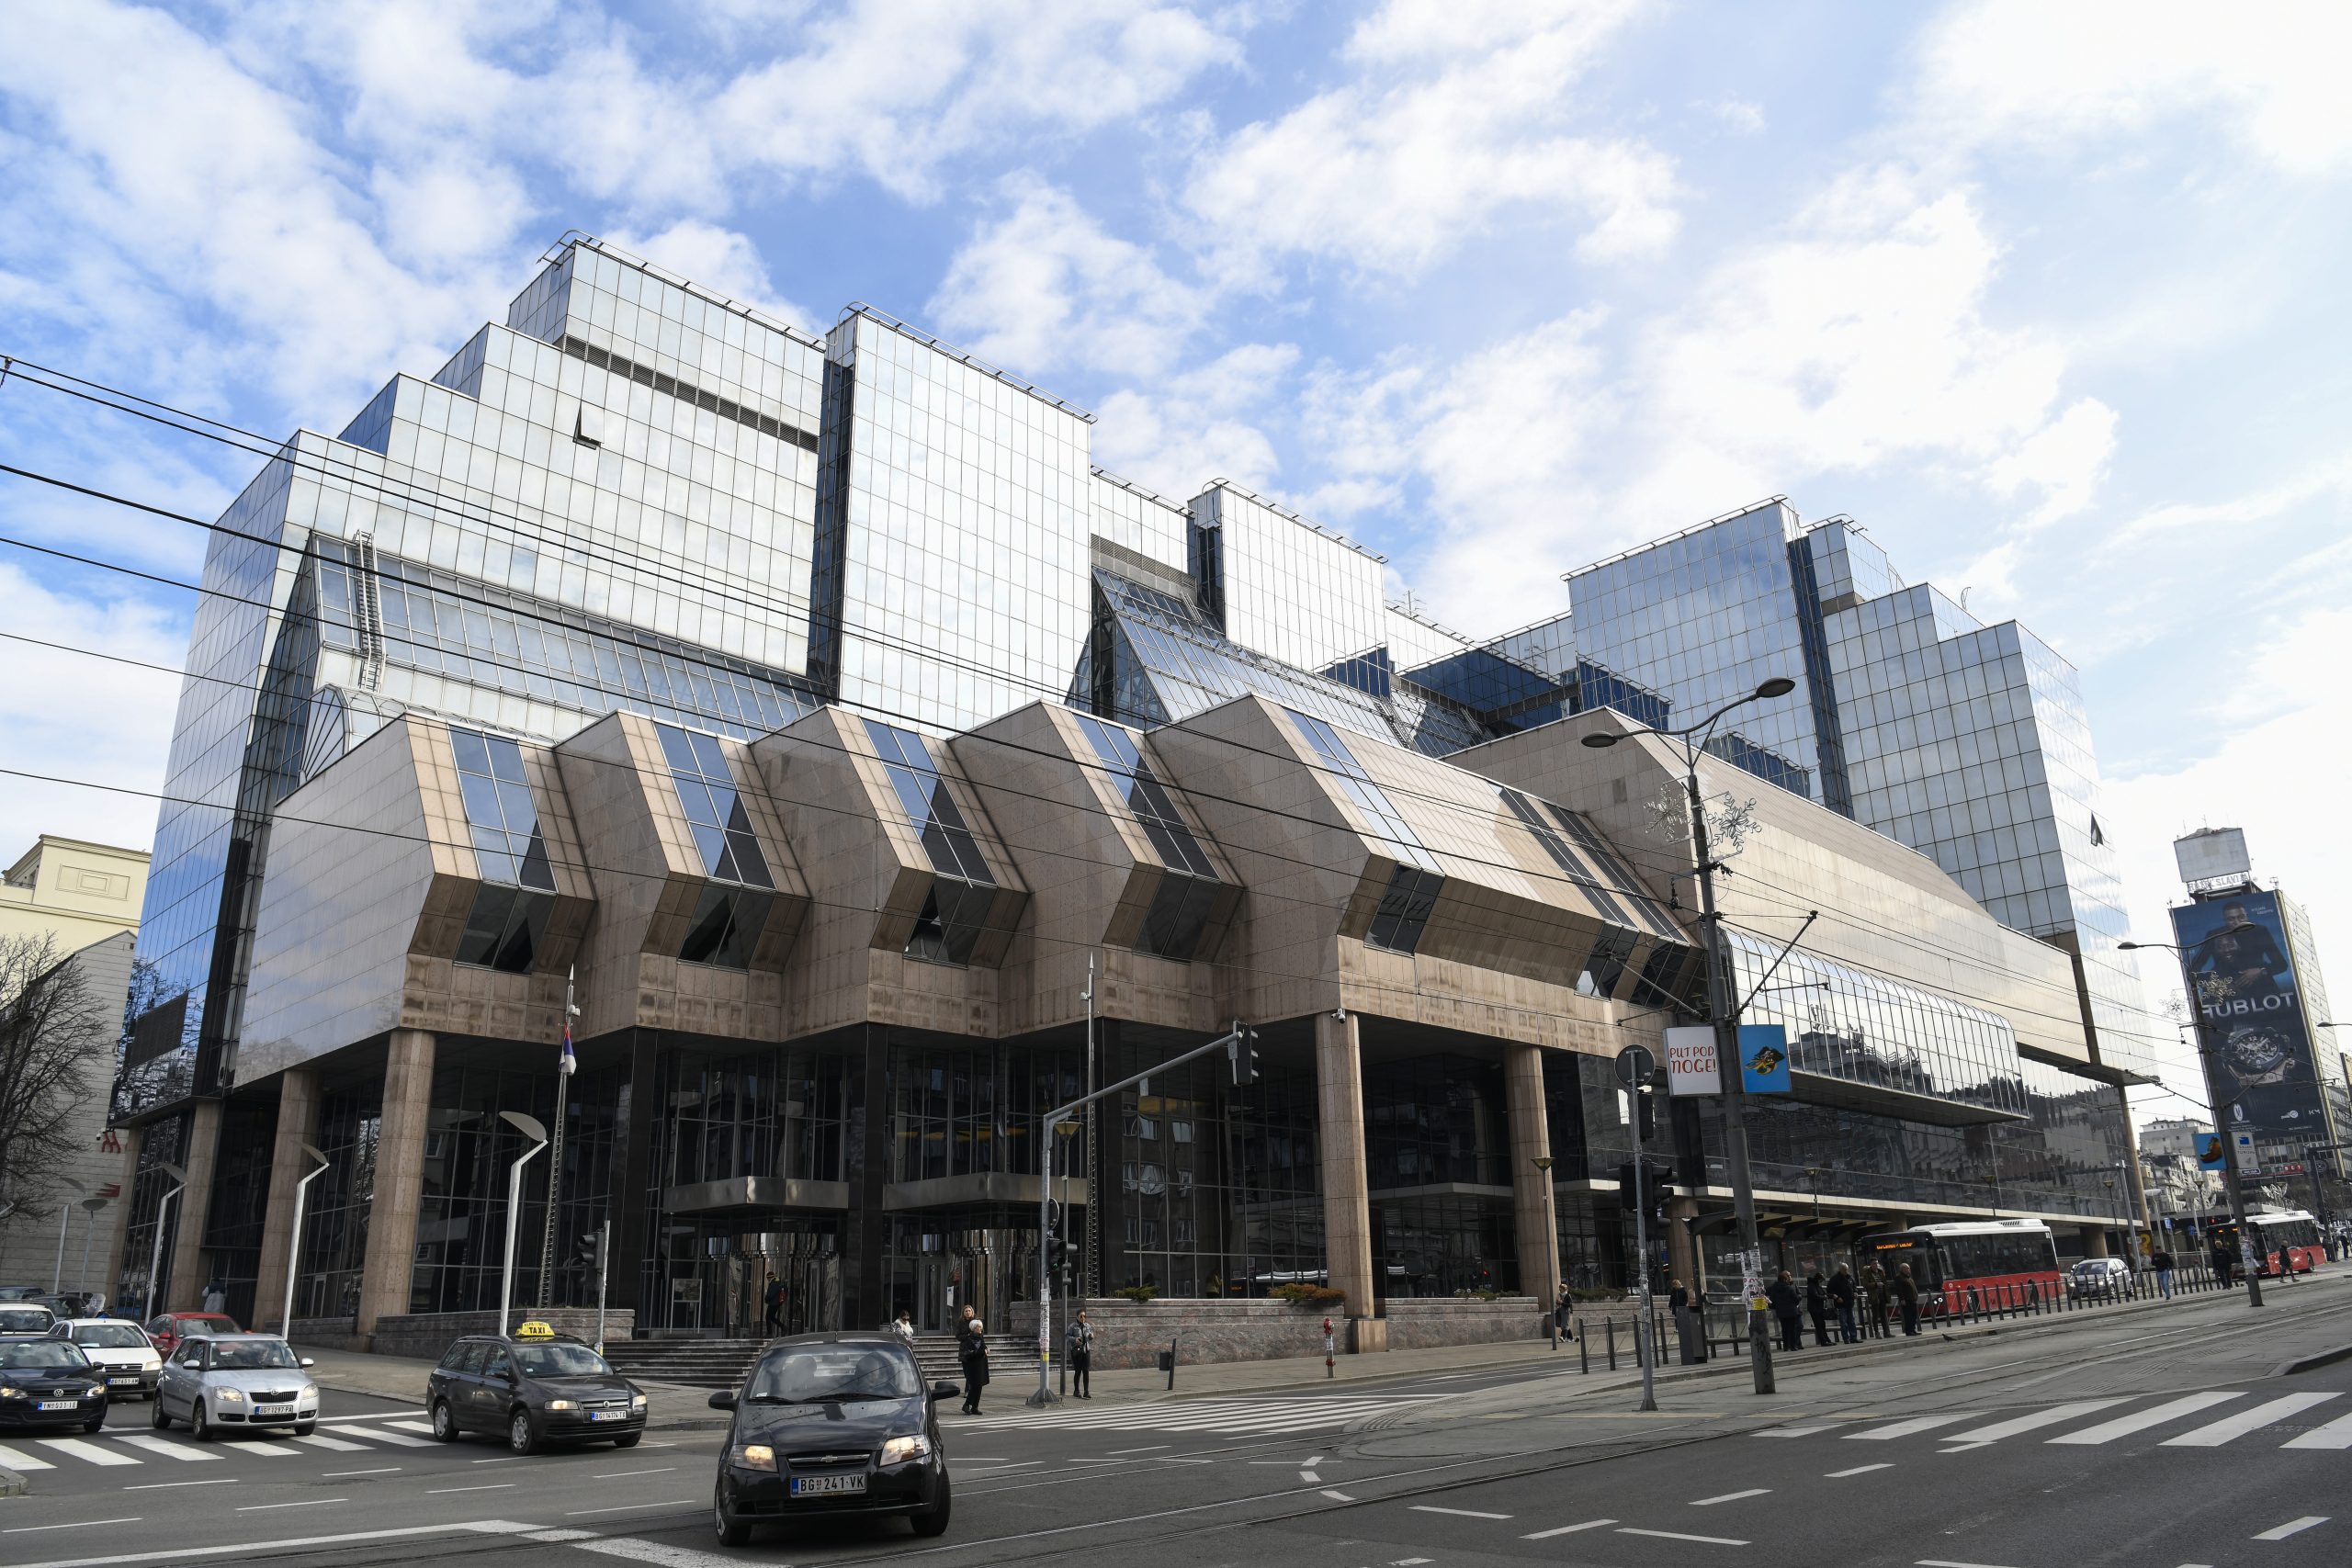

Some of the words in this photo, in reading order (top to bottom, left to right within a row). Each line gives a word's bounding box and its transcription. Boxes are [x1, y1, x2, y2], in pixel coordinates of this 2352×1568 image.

[1669, 1047, 1690, 1058] PUT
[1692, 1046, 1714, 1057] POD
[1671, 1059, 1716, 1074] NOGE!
[528, 1326, 546, 1335] TAXI
[801, 1479, 815, 1492] BG
